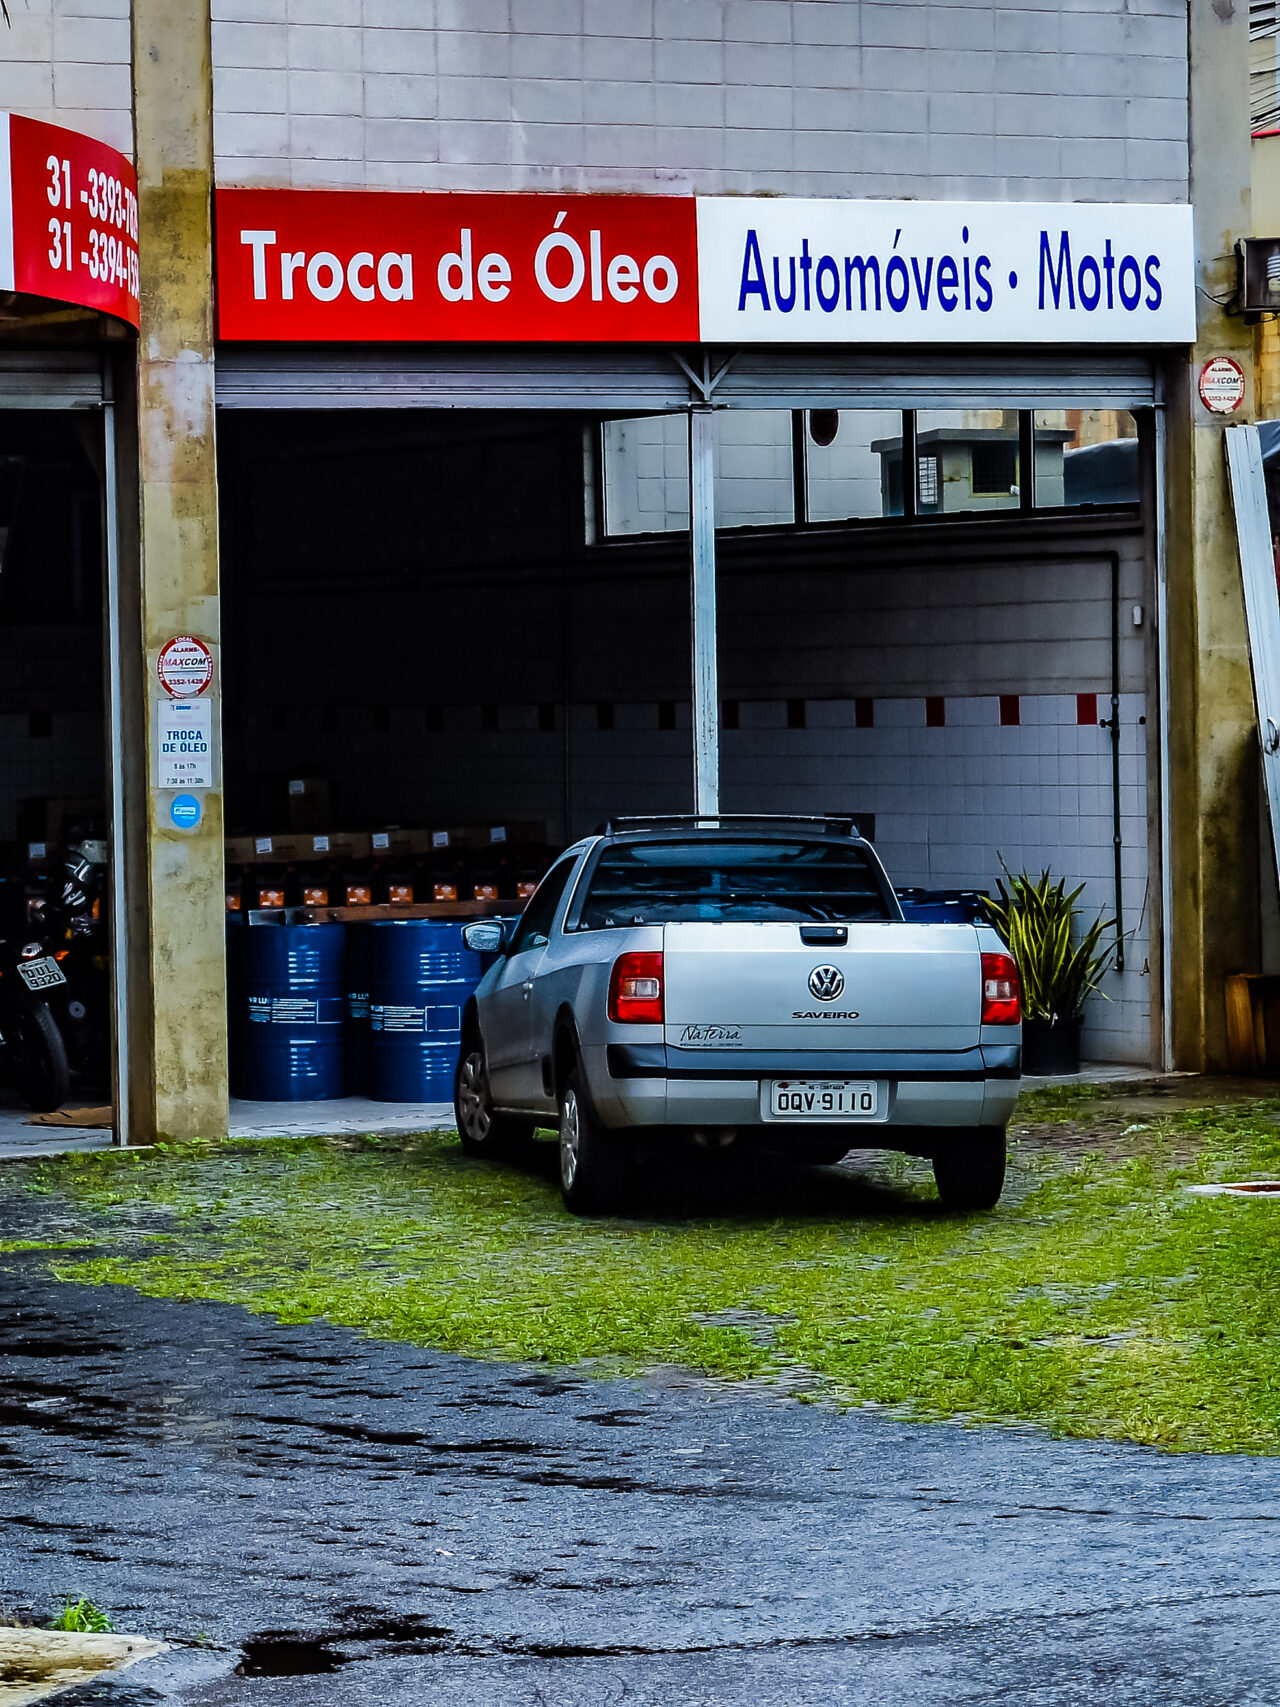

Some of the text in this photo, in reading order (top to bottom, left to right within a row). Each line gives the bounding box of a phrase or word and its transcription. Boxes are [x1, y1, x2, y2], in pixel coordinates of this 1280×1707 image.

[46, 155, 72, 209] 31
[48, 217, 73, 271] 31
[240, 211, 679, 303] Troca de Óleo
[737, 226, 1162, 313] Automóveis Motos
[163, 657, 206, 667] MAXCOM
[166, 730, 203, 741] TROCA
[162, 740, 208, 753] DE ÓLEO
[30, 972, 62, 988] 9320
[791, 1011, 860, 1019] SAVEIRO
